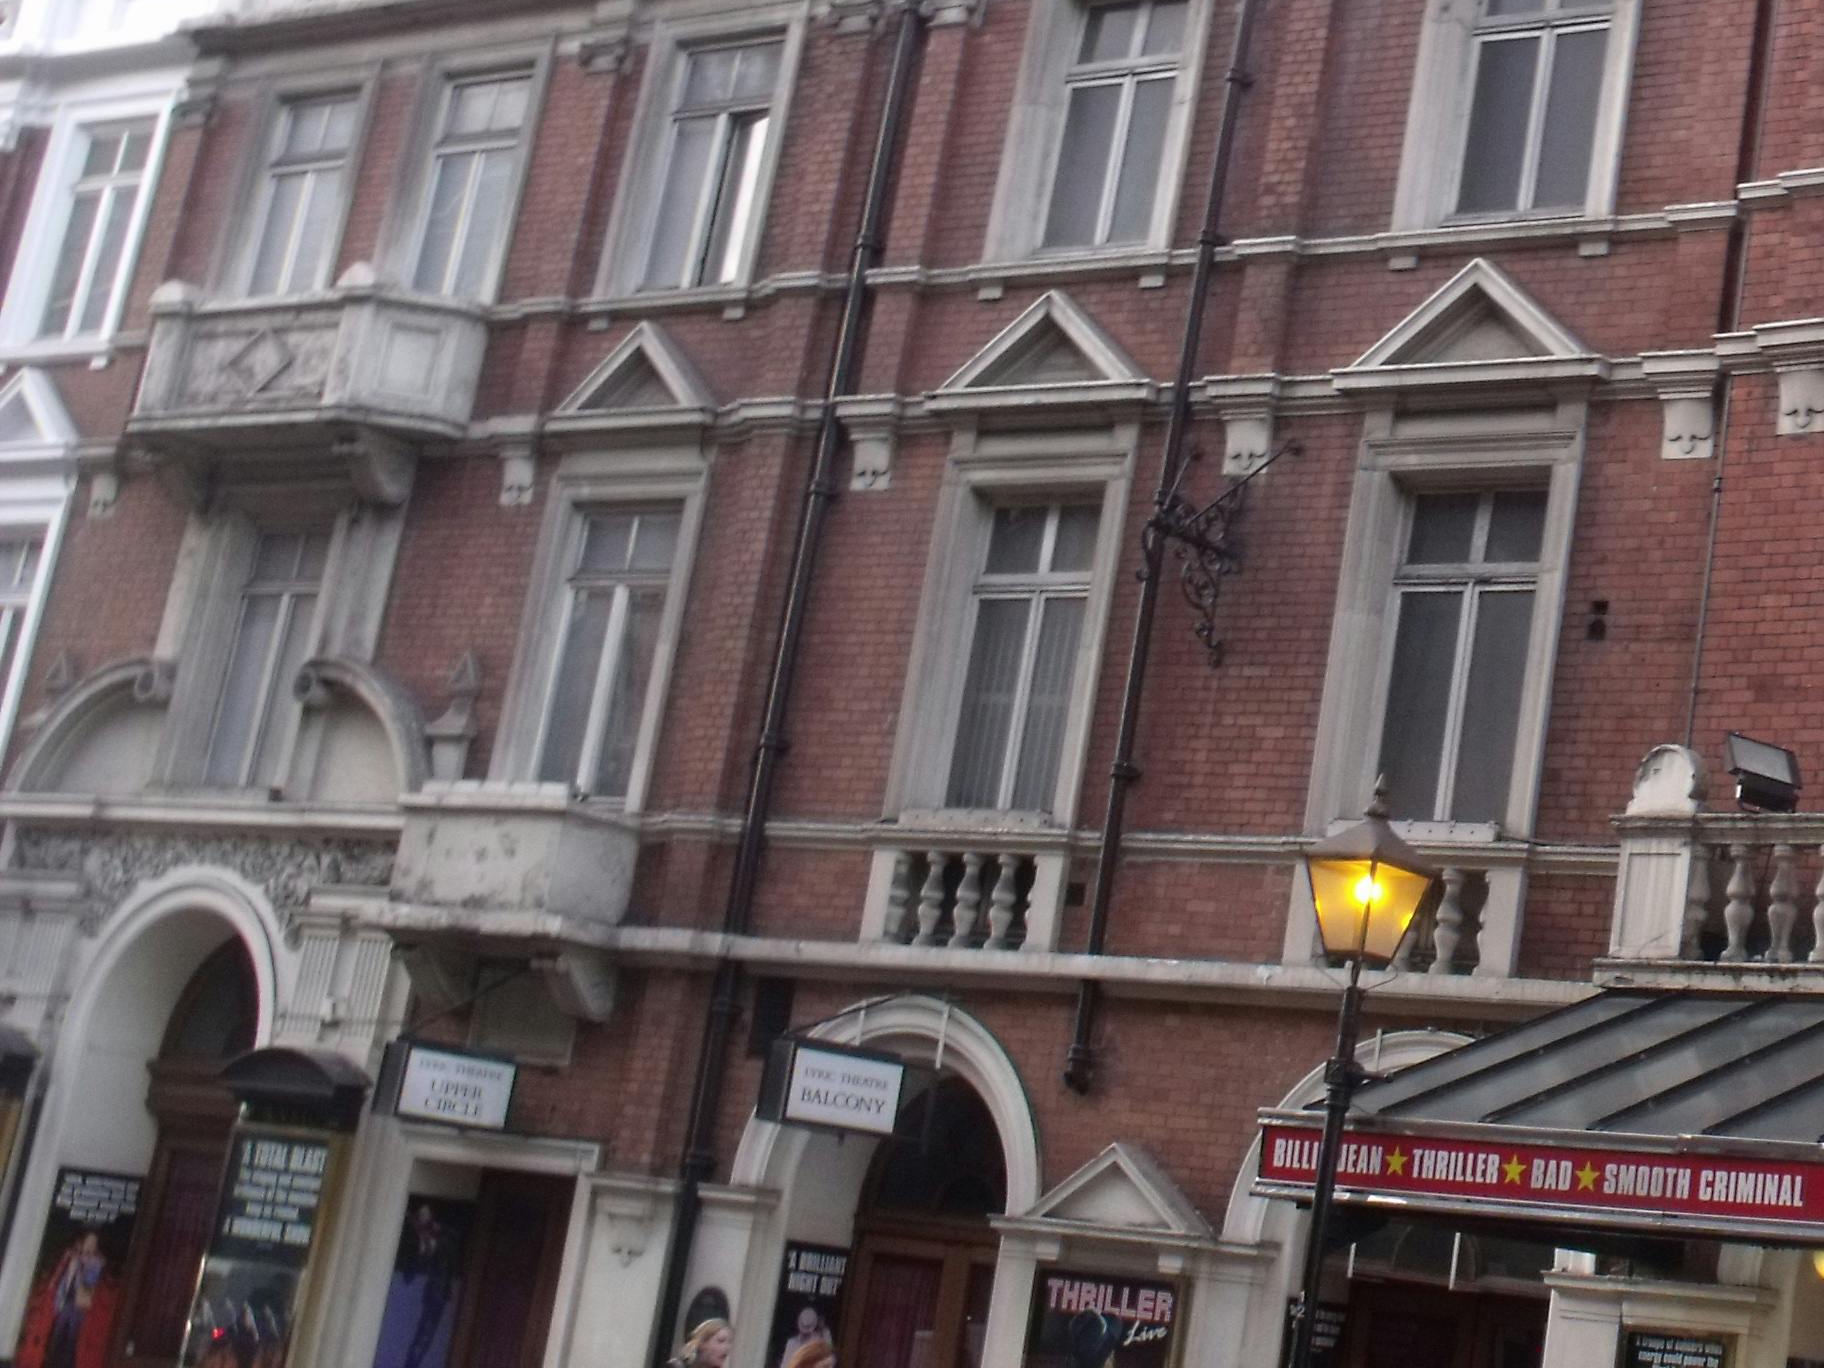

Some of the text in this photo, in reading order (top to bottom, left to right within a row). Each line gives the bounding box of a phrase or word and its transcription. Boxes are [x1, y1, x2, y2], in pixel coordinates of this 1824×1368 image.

[801, 1087, 885, 1114] BALCONY
[1273, 1138, 1383, 1175] BILLI JEAN
[1411, 1147, 1500, 1185] THRILLER
[1530, 1158, 1573, 1192] BAD
[1603, 1163, 1805, 1208] SMOOTH CRIMINAL
[1048, 1278, 1172, 1322] THRILLER
[1123, 1320, 1168, 1346] Live
